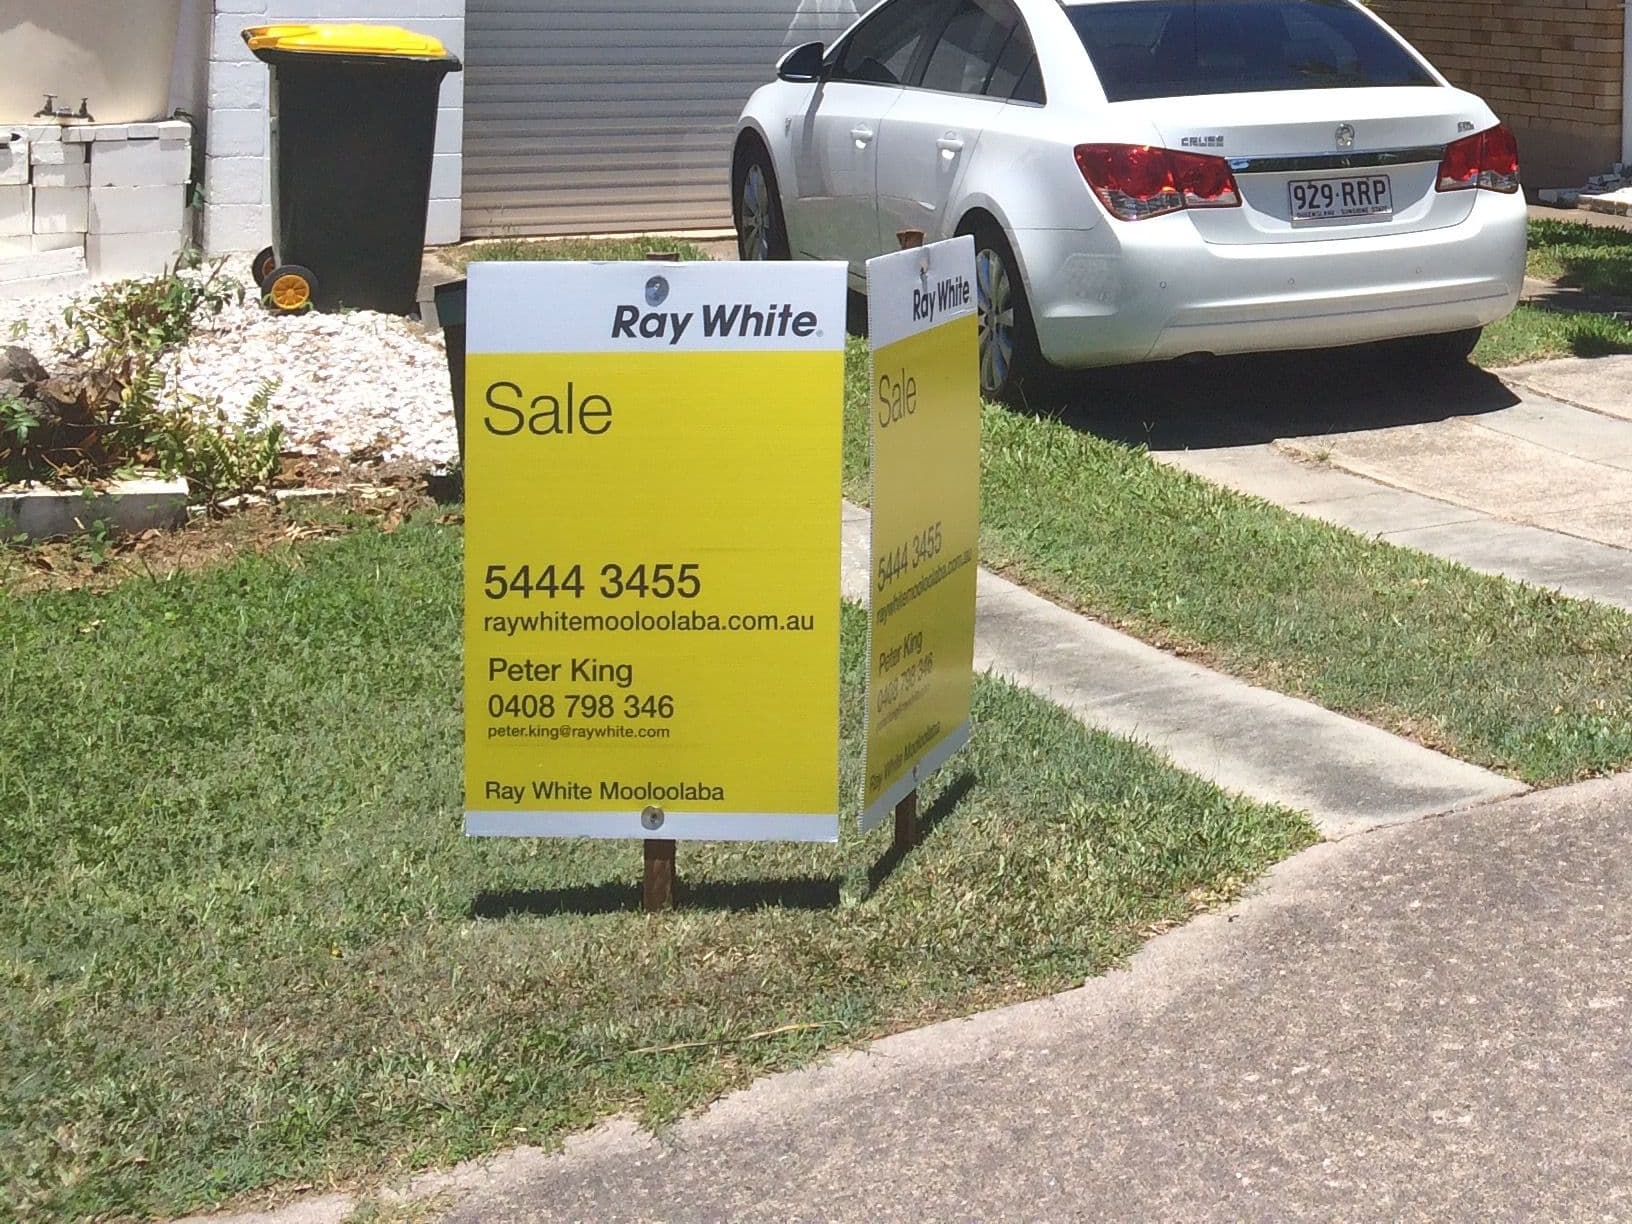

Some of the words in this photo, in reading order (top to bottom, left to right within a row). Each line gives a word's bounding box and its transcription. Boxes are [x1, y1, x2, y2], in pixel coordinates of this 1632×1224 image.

[1294, 183, 1333, 210] 929
[1341, 180, 1386, 206] RRP
[913, 288, 935, 322] Ray
[937, 276, 971, 312] White
[611, 304, 694, 345] Ray
[702, 303, 818, 338] White
[483, 381, 613, 436] Sale
[878, 368, 917, 429] Sale
[877, 542, 908, 592] 5444
[912, 521, 942, 569] 3455
[484, 564, 585, 600] 5444
[599, 564, 701, 599] 3455
[484, 610, 814, 634] raywhitemooloolaba.com.au
[879, 645, 902, 676] Peter
[903, 631, 923, 658] King
[488, 657, 562, 683] Peter
[571, 658, 633, 688] King
[488, 694, 556, 719] 0408
[564, 694, 615, 719] 798
[623, 694, 674, 719] 346
[488, 724, 670, 741] peter.king@raywhite.com
[484, 780, 526, 804] Ray
[531, 781, 593, 800] White
[600, 781, 725, 801] Mooloolaba
